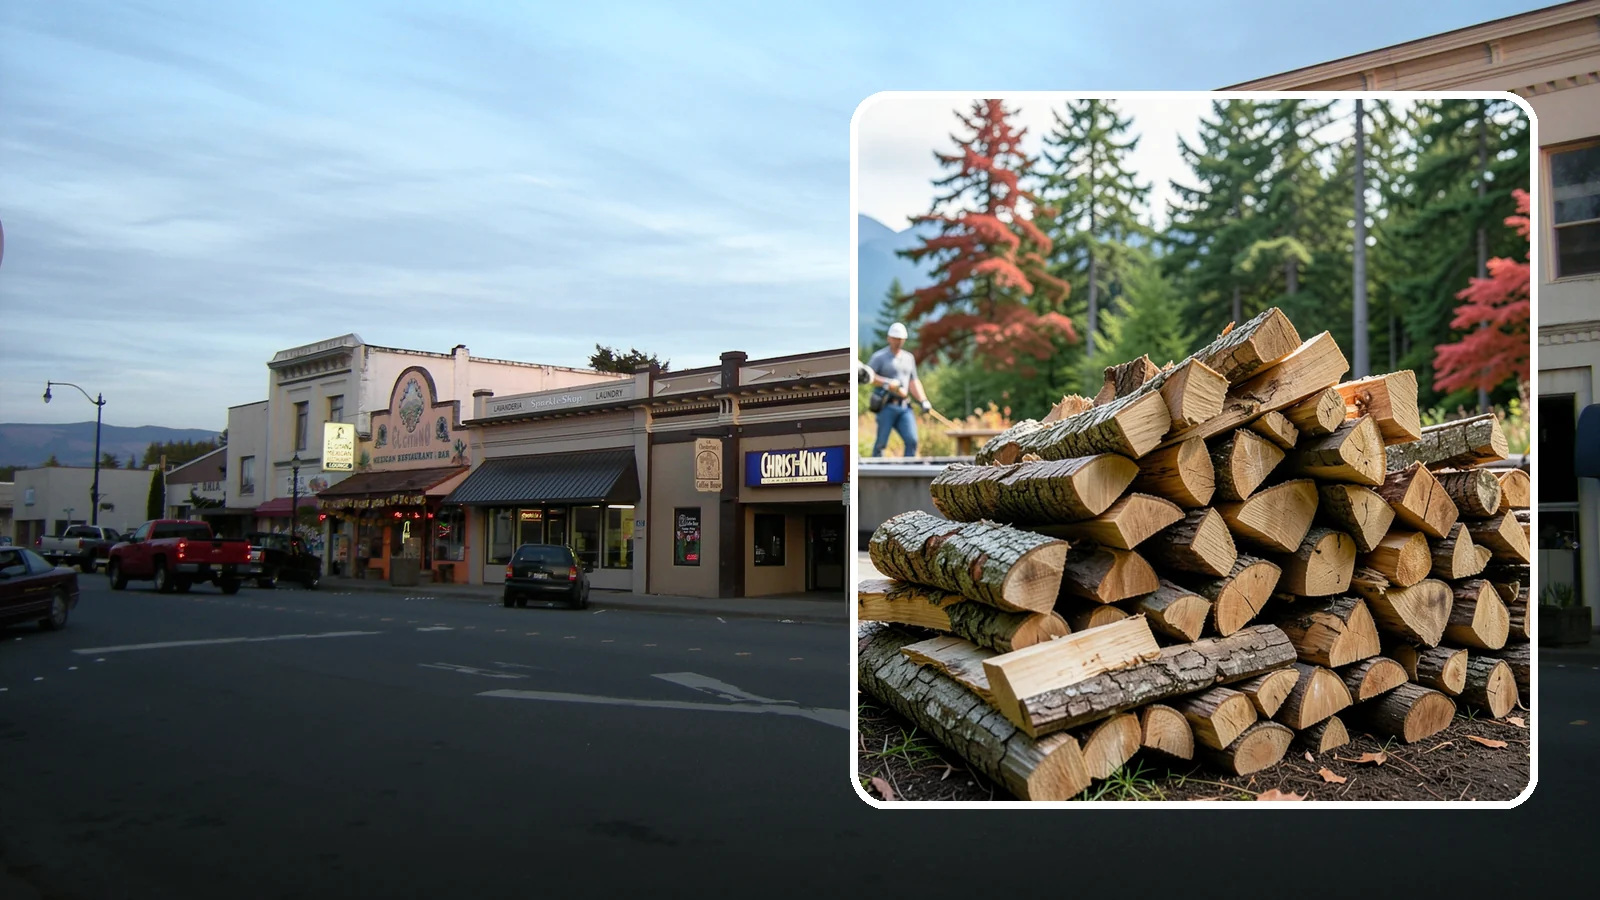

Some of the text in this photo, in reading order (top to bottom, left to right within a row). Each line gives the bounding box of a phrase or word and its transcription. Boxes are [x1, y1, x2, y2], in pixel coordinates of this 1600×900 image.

[595, 389, 623, 400] LAUNDRY
[530, 394, 582, 408] Sparkle Shop
[493, 402, 522, 413] LAVANDERIA
[373, 450, 450, 464] MEXICAN RESTAURANT BAR
[761, 450, 827, 478] CHRIST KING
[696, 480, 709, 488] Coffee
